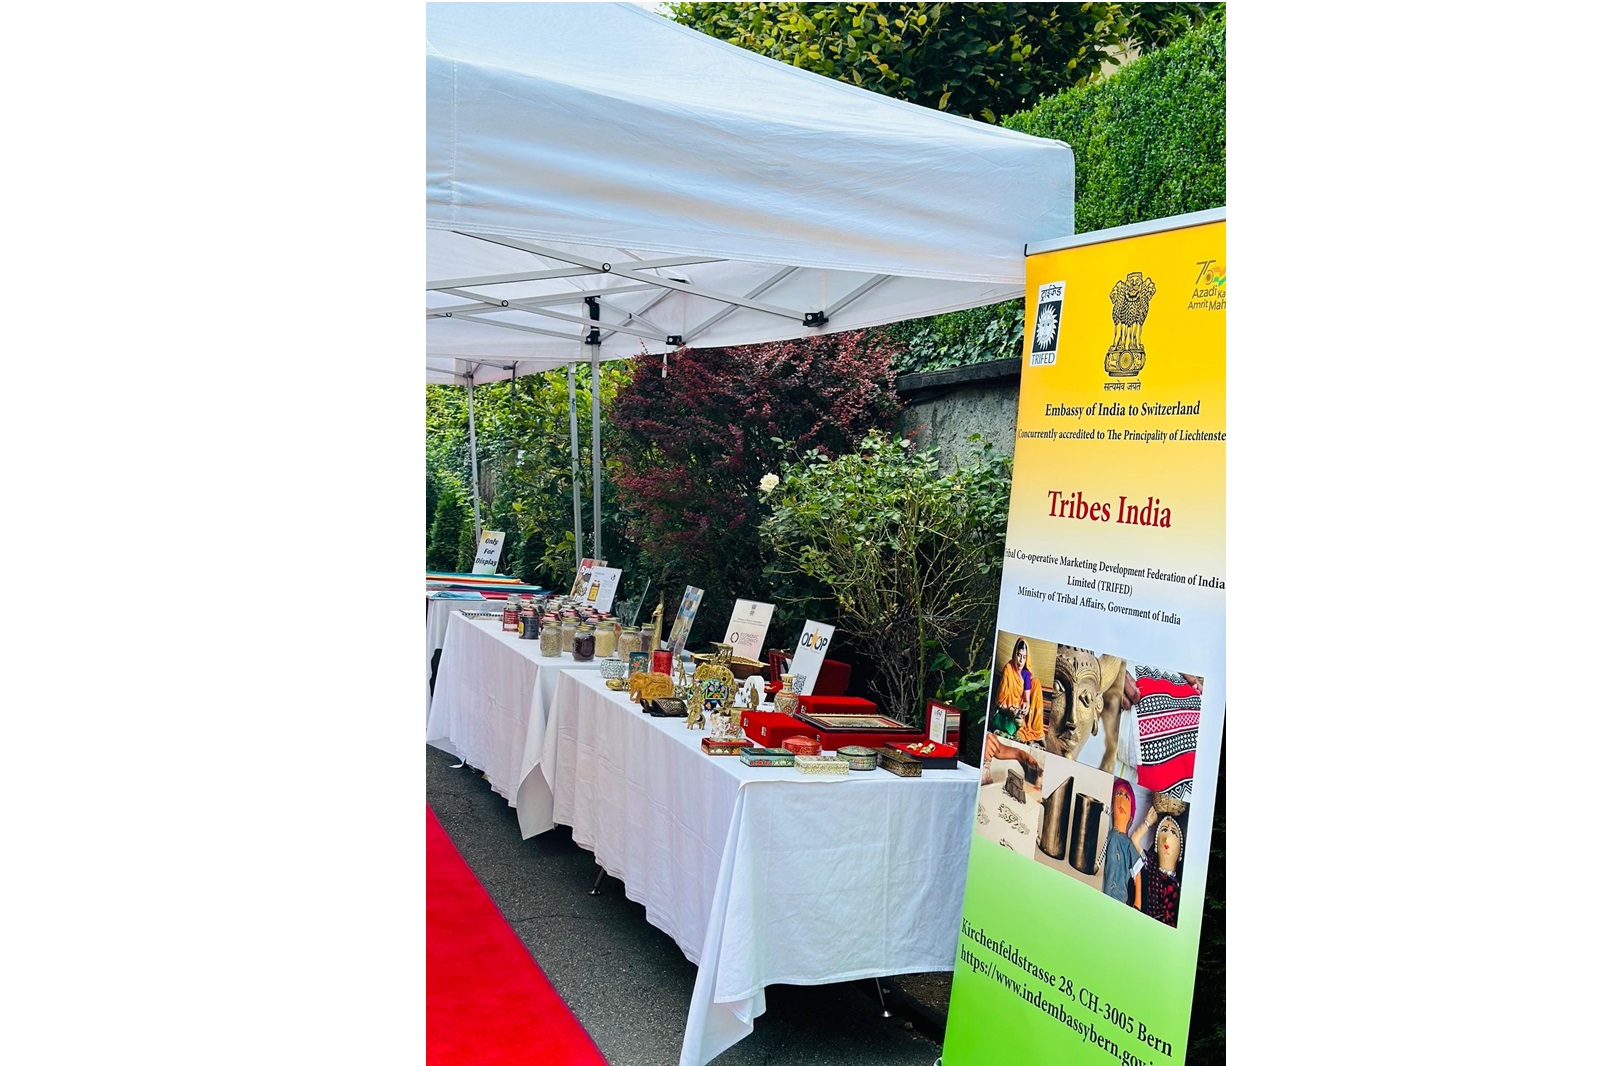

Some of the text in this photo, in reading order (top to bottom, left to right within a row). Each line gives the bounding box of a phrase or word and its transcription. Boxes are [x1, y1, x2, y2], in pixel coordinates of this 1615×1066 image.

[1192, 285, 1218, 299] Azadi
[1187, 299, 1209, 310] Amrit
[1032, 352, 1056, 365] TRIFED
[1045, 400, 1200, 419] Embassy of India to Switzerland
[1018, 429, 1226, 444] Concurrently accredited to The Principality of Liechtenste
[1048, 490, 1172, 528] Tribes India
[485, 538, 499, 546] Only
[475, 557, 497, 567] Display
[1016, 549, 1059, 565] Co-operative
[1059, 555, 1097, 573] Marketing
[1099, 562, 1145, 578] Development
[1147, 568, 1186, 585] Federation
[1187, 574, 1197, 586] of
[1198, 575, 1226, 590] India
[1067, 576, 1133, 597] Limited (TRIFED)
[1017, 586, 1181, 626] Ministry of Tribal Affairs, Government of India
[961, 917, 1173, 1058] Kirchenfeldstrasse 28, CH-3005 Bern
[960, 944, 1153, 1066] https://www.indembassybern.gov
